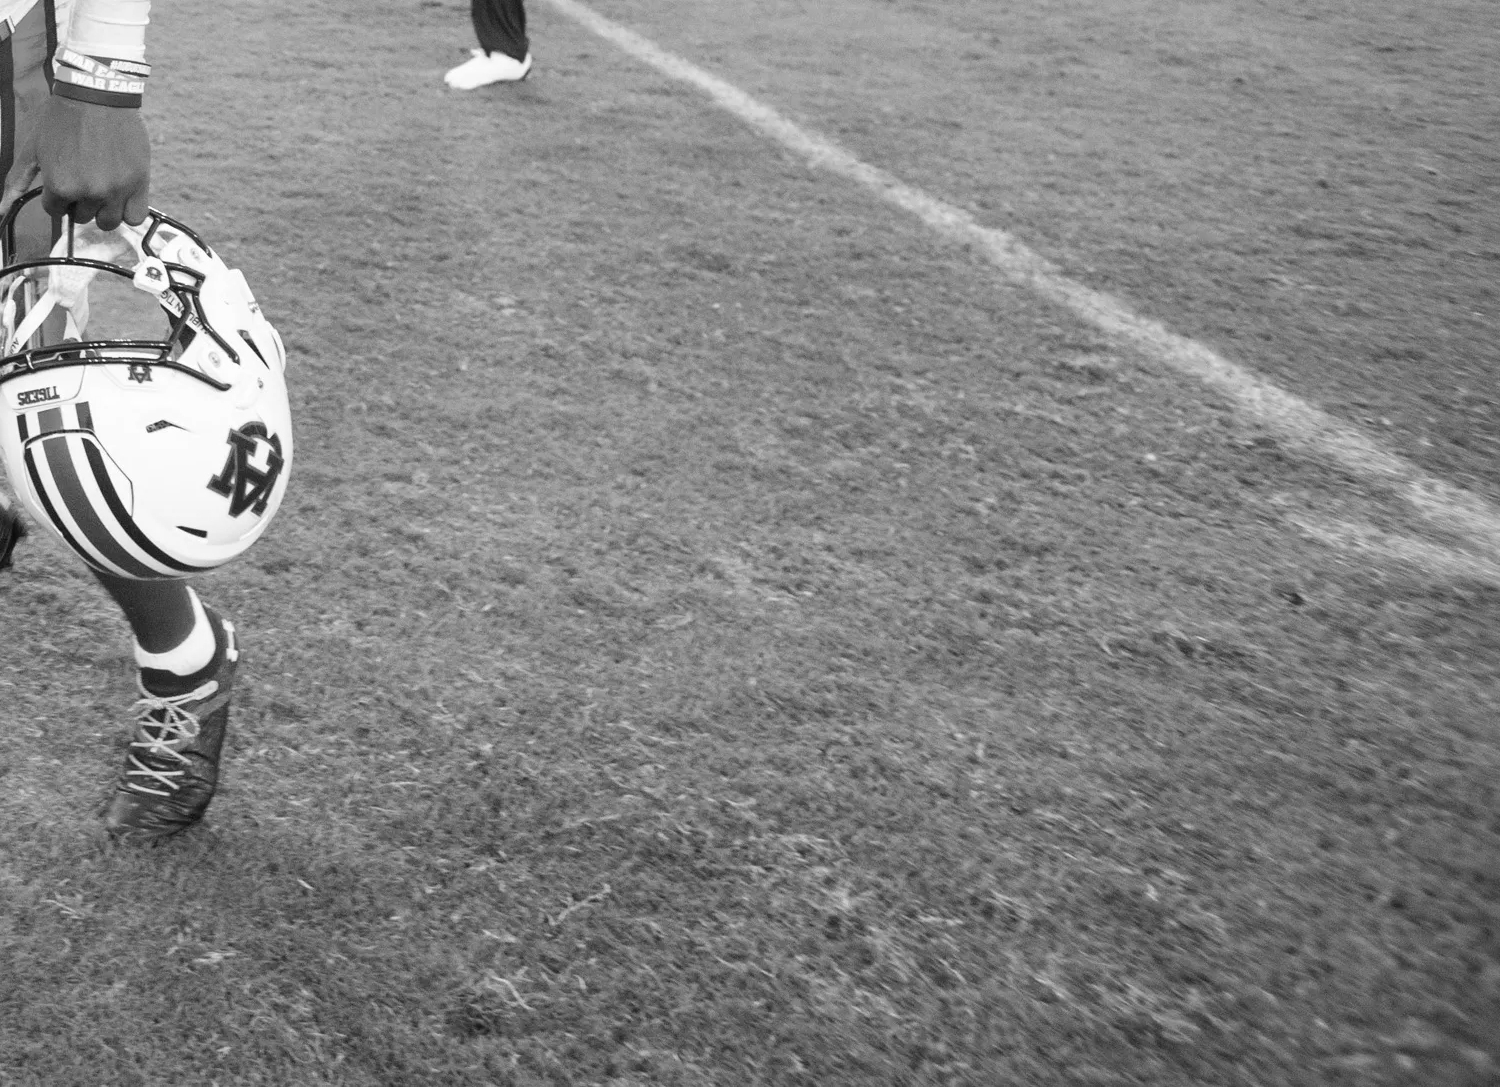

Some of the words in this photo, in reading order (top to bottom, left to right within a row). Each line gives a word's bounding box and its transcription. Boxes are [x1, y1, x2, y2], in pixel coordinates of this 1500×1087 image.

[62, 48, 96, 74] WAR
[71, 70, 107, 91] WAR
[17, 385, 60, 406] TIGERS
